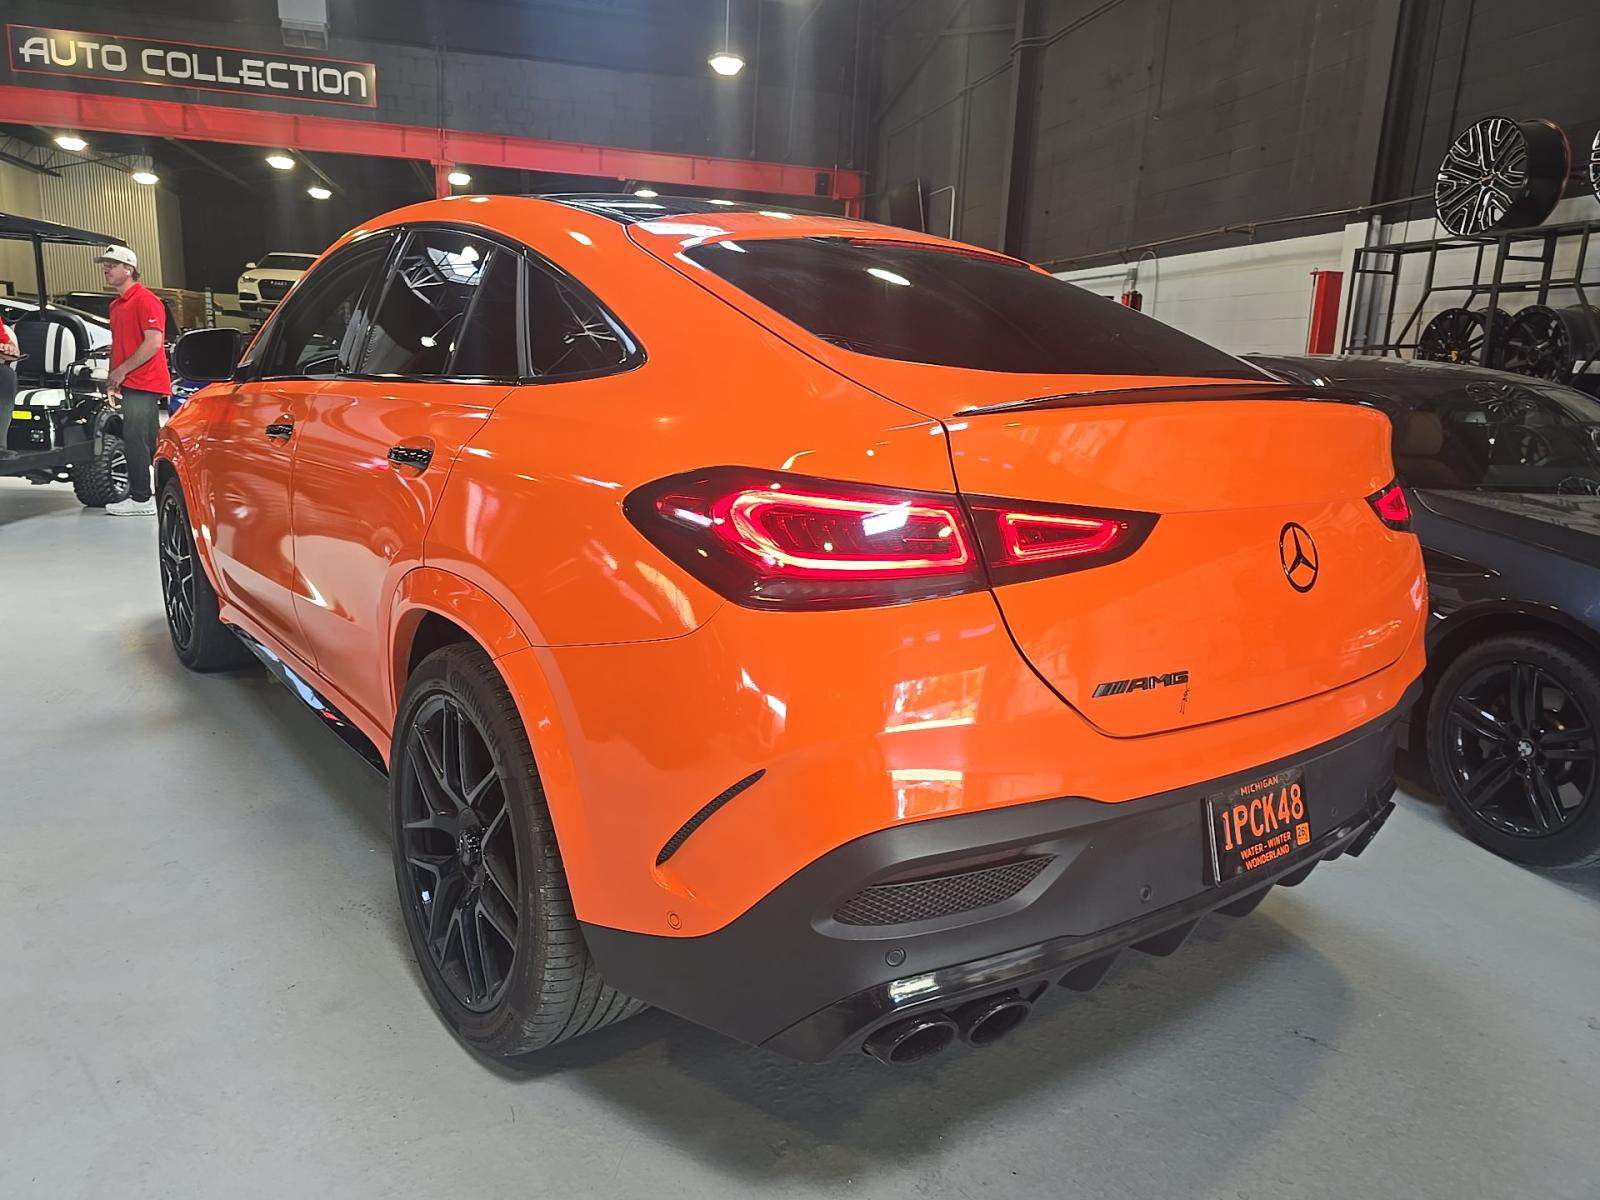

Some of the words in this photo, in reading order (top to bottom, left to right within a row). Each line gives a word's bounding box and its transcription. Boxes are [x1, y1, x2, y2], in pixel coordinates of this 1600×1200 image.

[19, 37, 128, 72] AUTO
[141, 48, 367, 98] COLLECTION
[1240, 776, 1279, 796] MICHIGAN
[1222, 783, 1305, 851] 1PCK48
[1245, 843, 1291, 871] WONDERLAND
